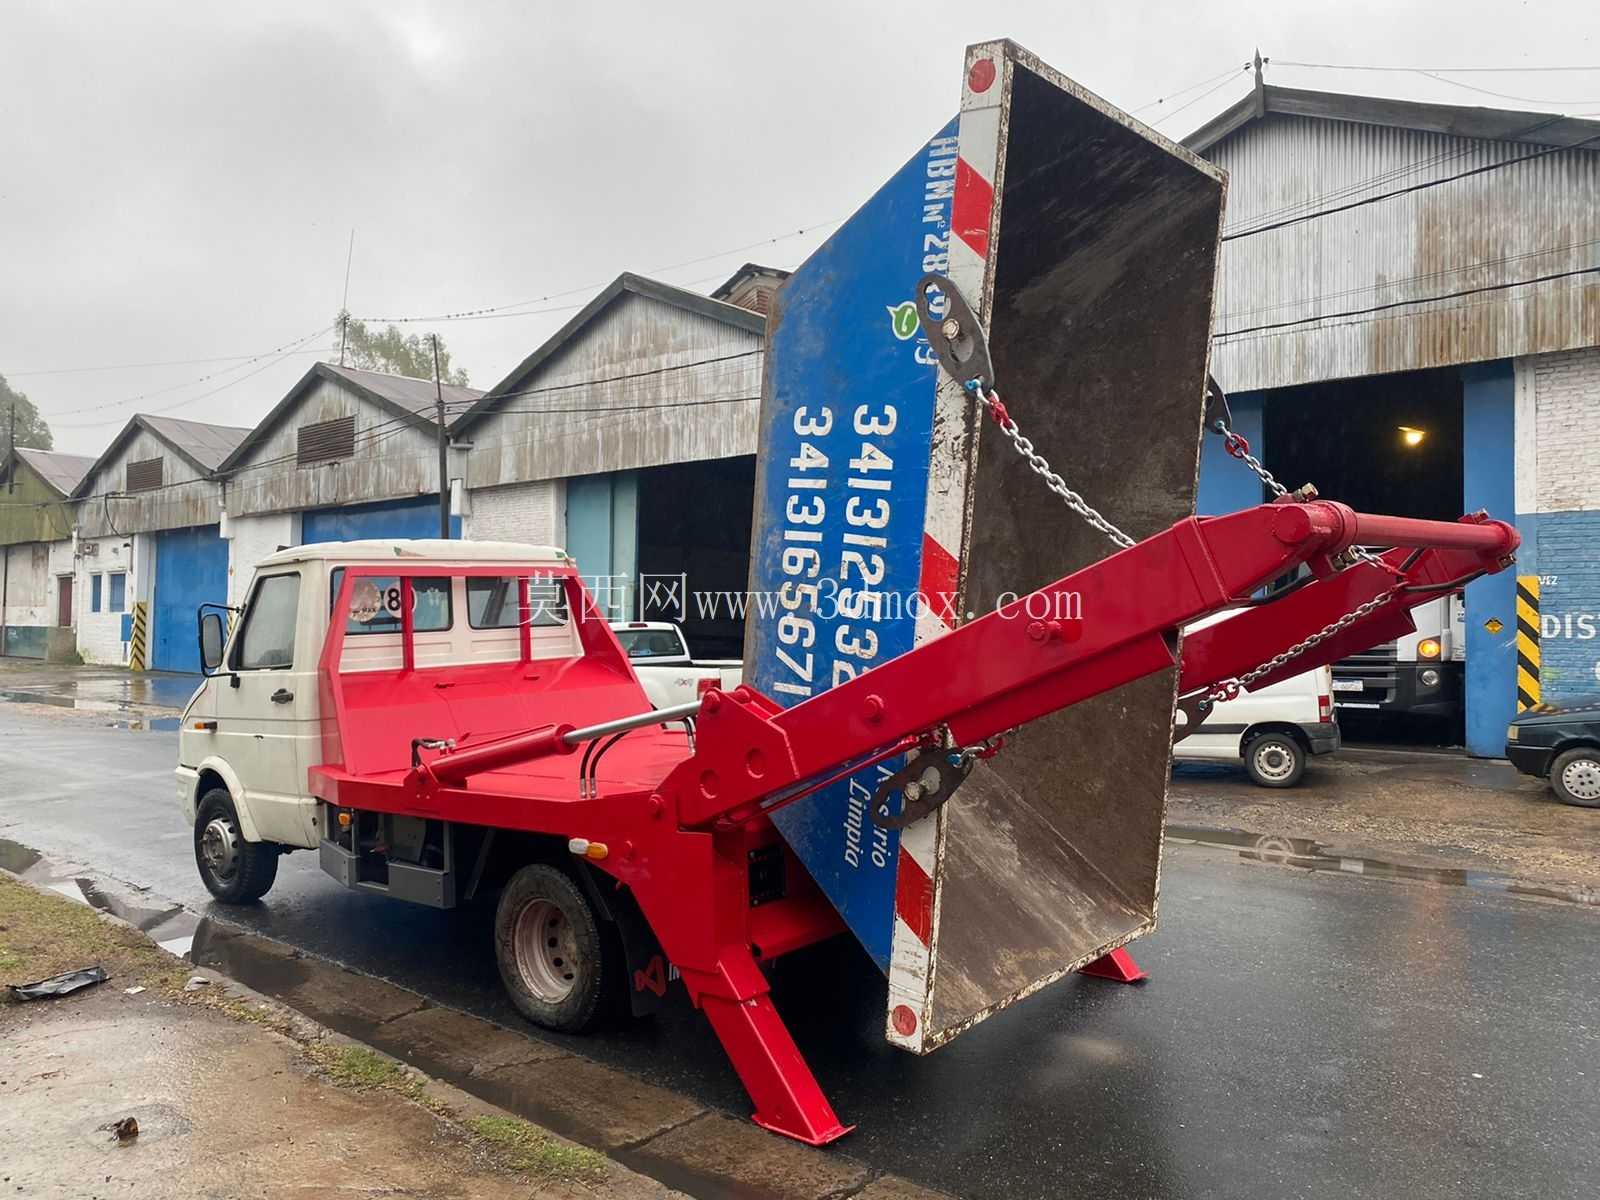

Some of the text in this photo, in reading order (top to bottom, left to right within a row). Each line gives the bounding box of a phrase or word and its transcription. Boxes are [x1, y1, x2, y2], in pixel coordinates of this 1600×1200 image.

[773, 405, 833, 697] 3413165671
[1541, 613, 1600, 640] DIS
[842, 777, 872, 868] Limpia
